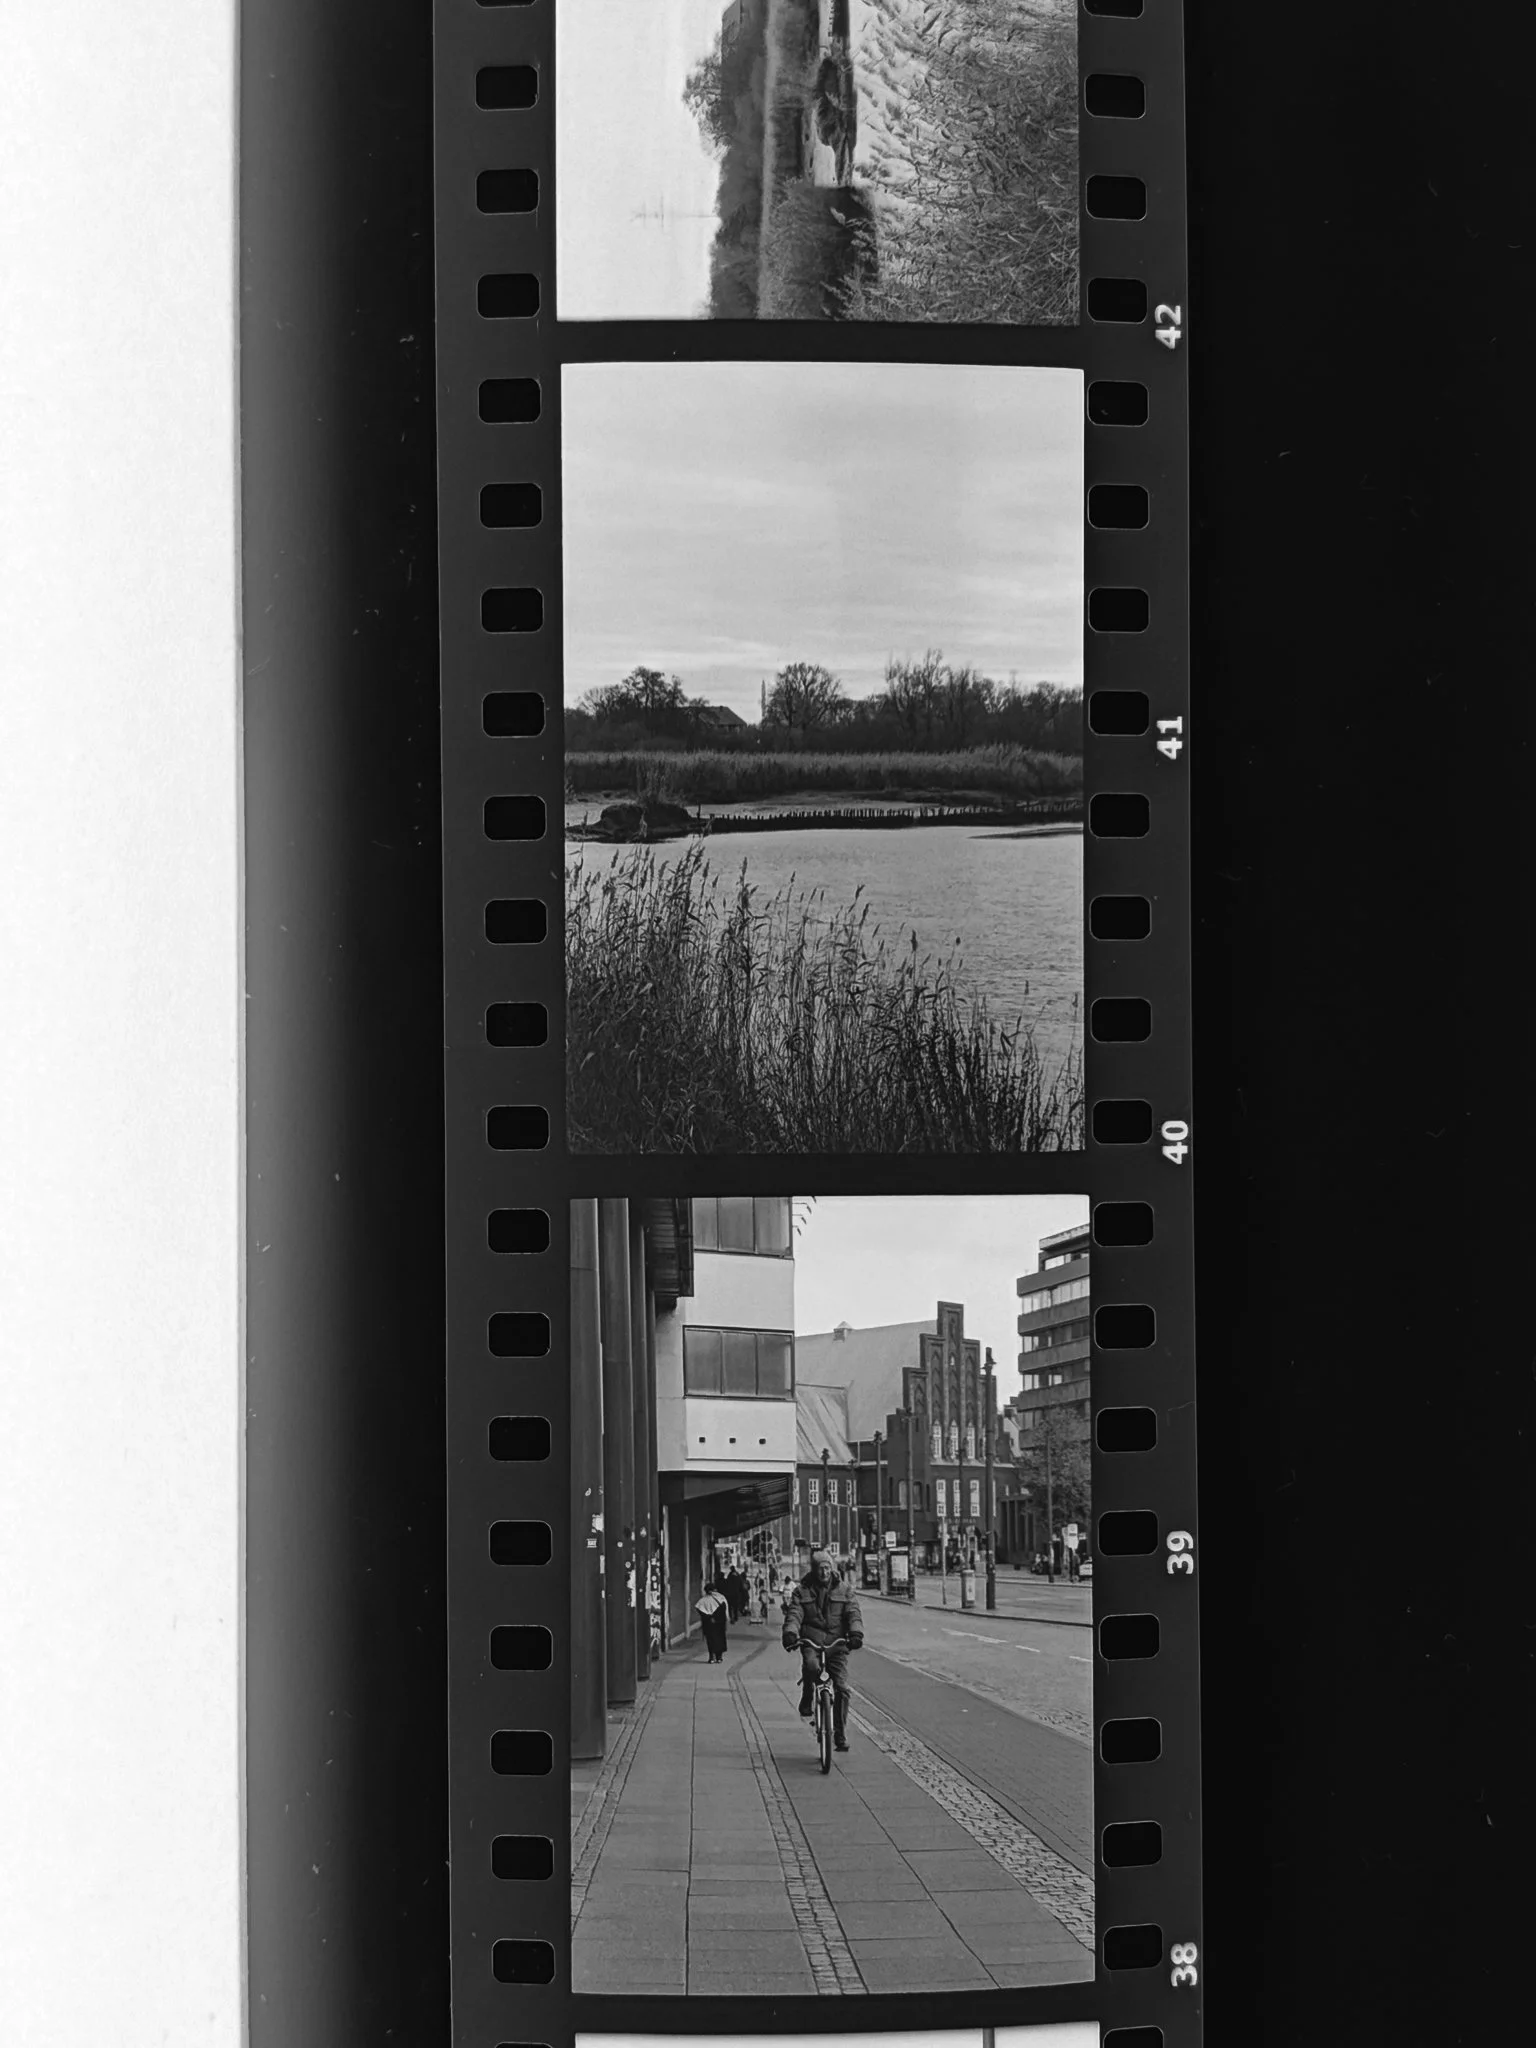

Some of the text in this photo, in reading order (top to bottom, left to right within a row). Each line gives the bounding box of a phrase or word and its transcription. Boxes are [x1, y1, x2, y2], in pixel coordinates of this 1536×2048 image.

[1154, 303, 1183, 349] 42
[1156, 714, 1184, 760] 41
[1161, 1119, 1190, 1165] 40
[1165, 1529, 1195, 1575] 39
[1169, 1942, 1199, 1988] 38
